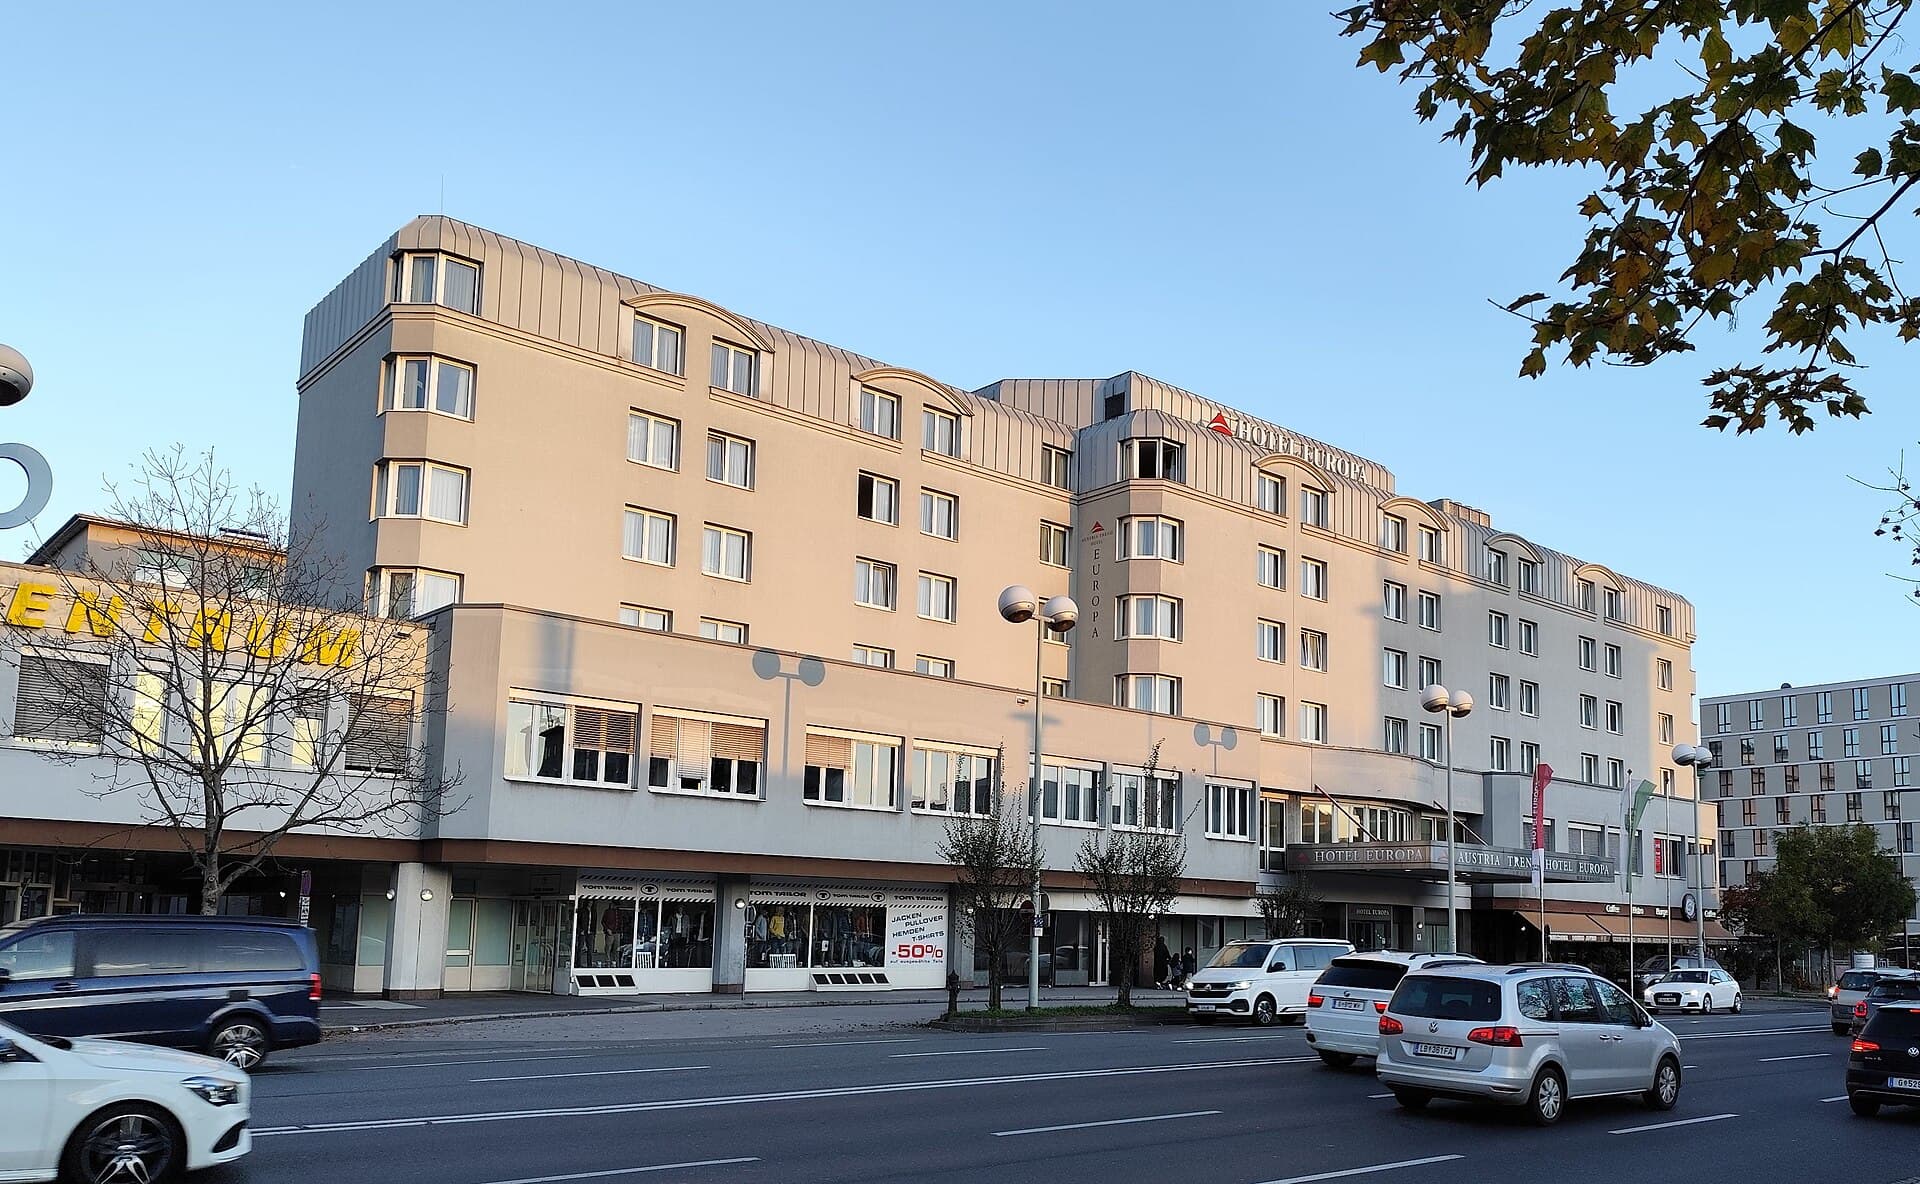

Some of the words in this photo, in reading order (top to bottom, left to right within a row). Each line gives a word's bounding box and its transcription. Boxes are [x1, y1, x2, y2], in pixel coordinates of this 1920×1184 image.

[1238, 419, 1300, 457] HOTEL
[1302, 443, 1367, 481] EUROPA
[1091, 548, 1101, 639] EUROPA
[1315, 850, 1361, 862] HOTEL
[1366, 848, 1424, 861] EUROPA
[1458, 852, 1501, 866] AUSTRIA
[1507, 855, 1533, 868] TREN
[1545, 859, 1573, 872] HOTEL
[1579, 860, 1609, 875] EUROPA
[891, 911, 922, 923] JACKEN
[904, 914, 943, 927] PULLOVER
[892, 926, 925, 938] HEMDEN
[891, 944, 943, 958] -50%
